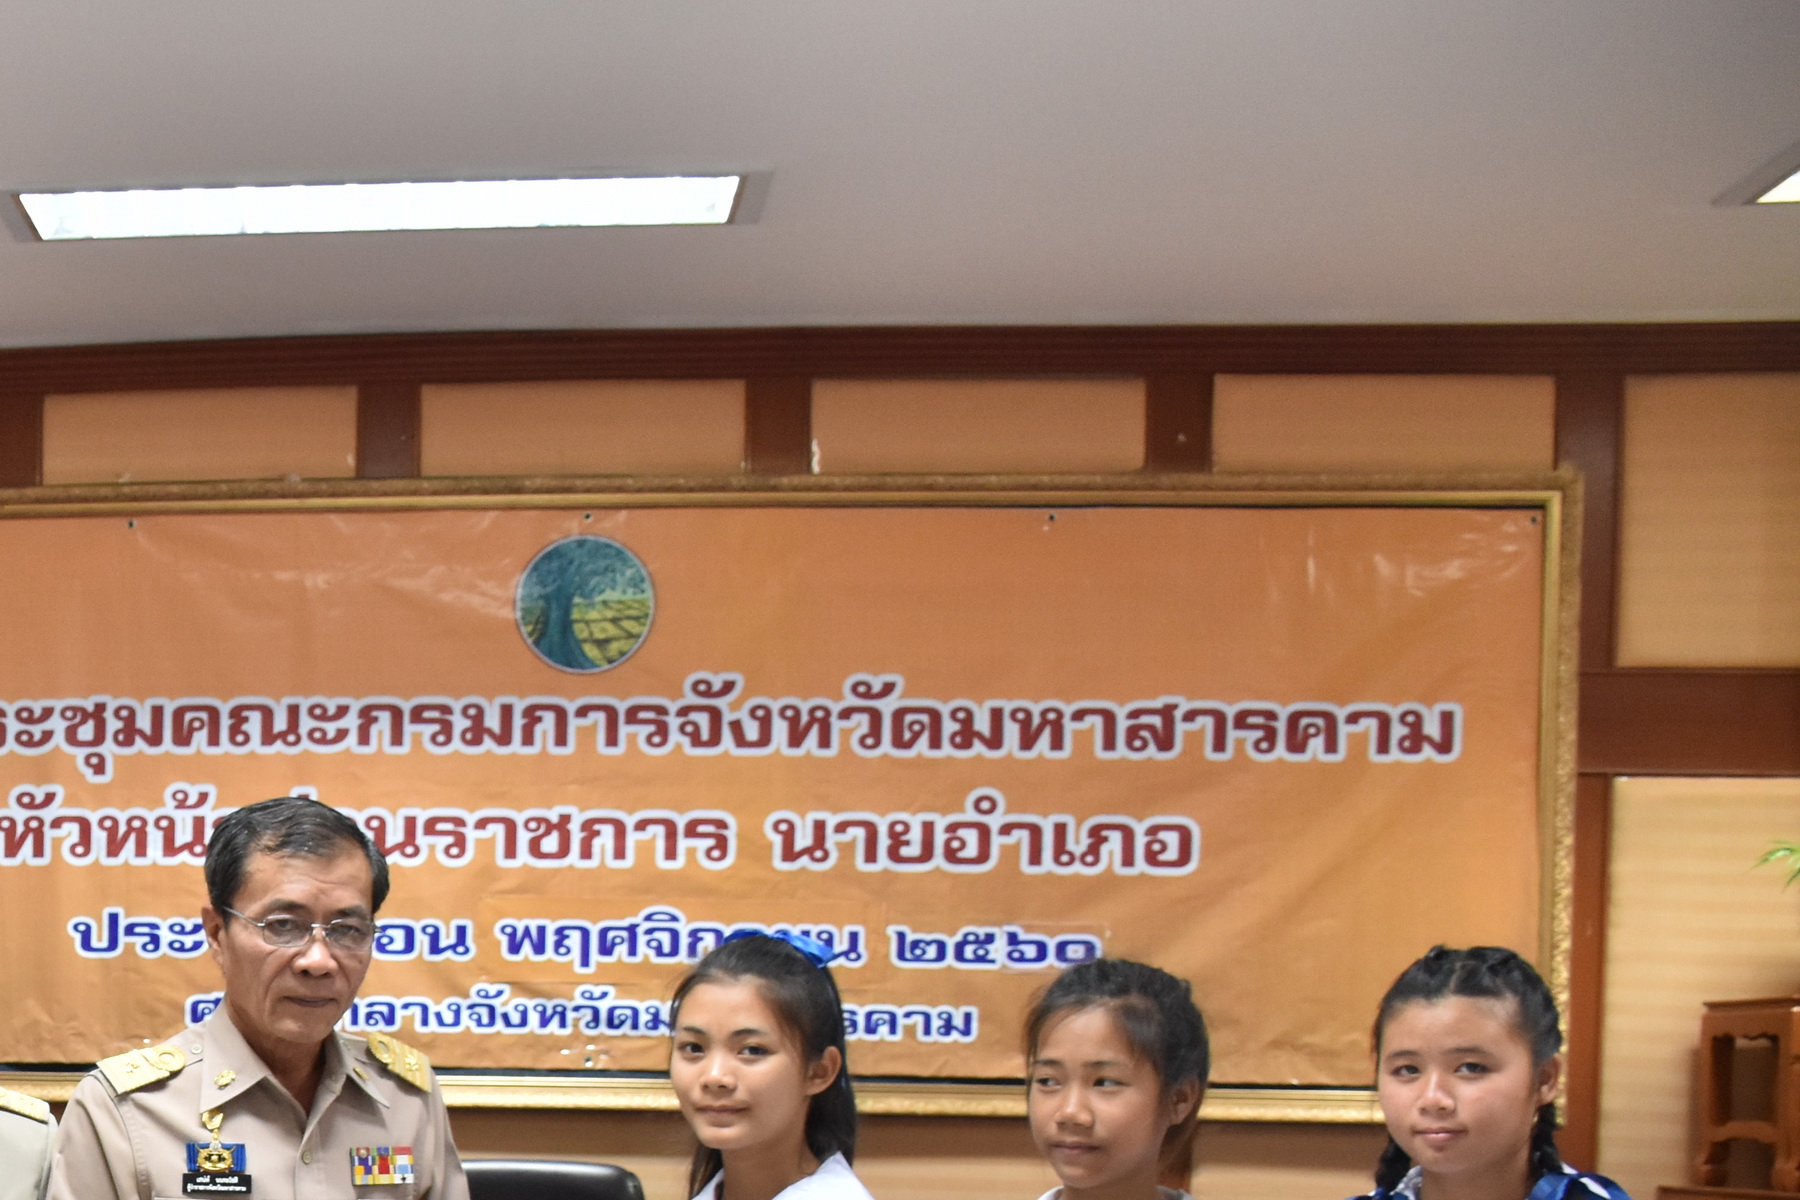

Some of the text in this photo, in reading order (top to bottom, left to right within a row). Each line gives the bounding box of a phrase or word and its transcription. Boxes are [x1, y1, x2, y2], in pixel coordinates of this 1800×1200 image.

[772, 794, 1194, 869] นายอำเภอ
[894, 930, 1099, 965] ๒๕๖๐
